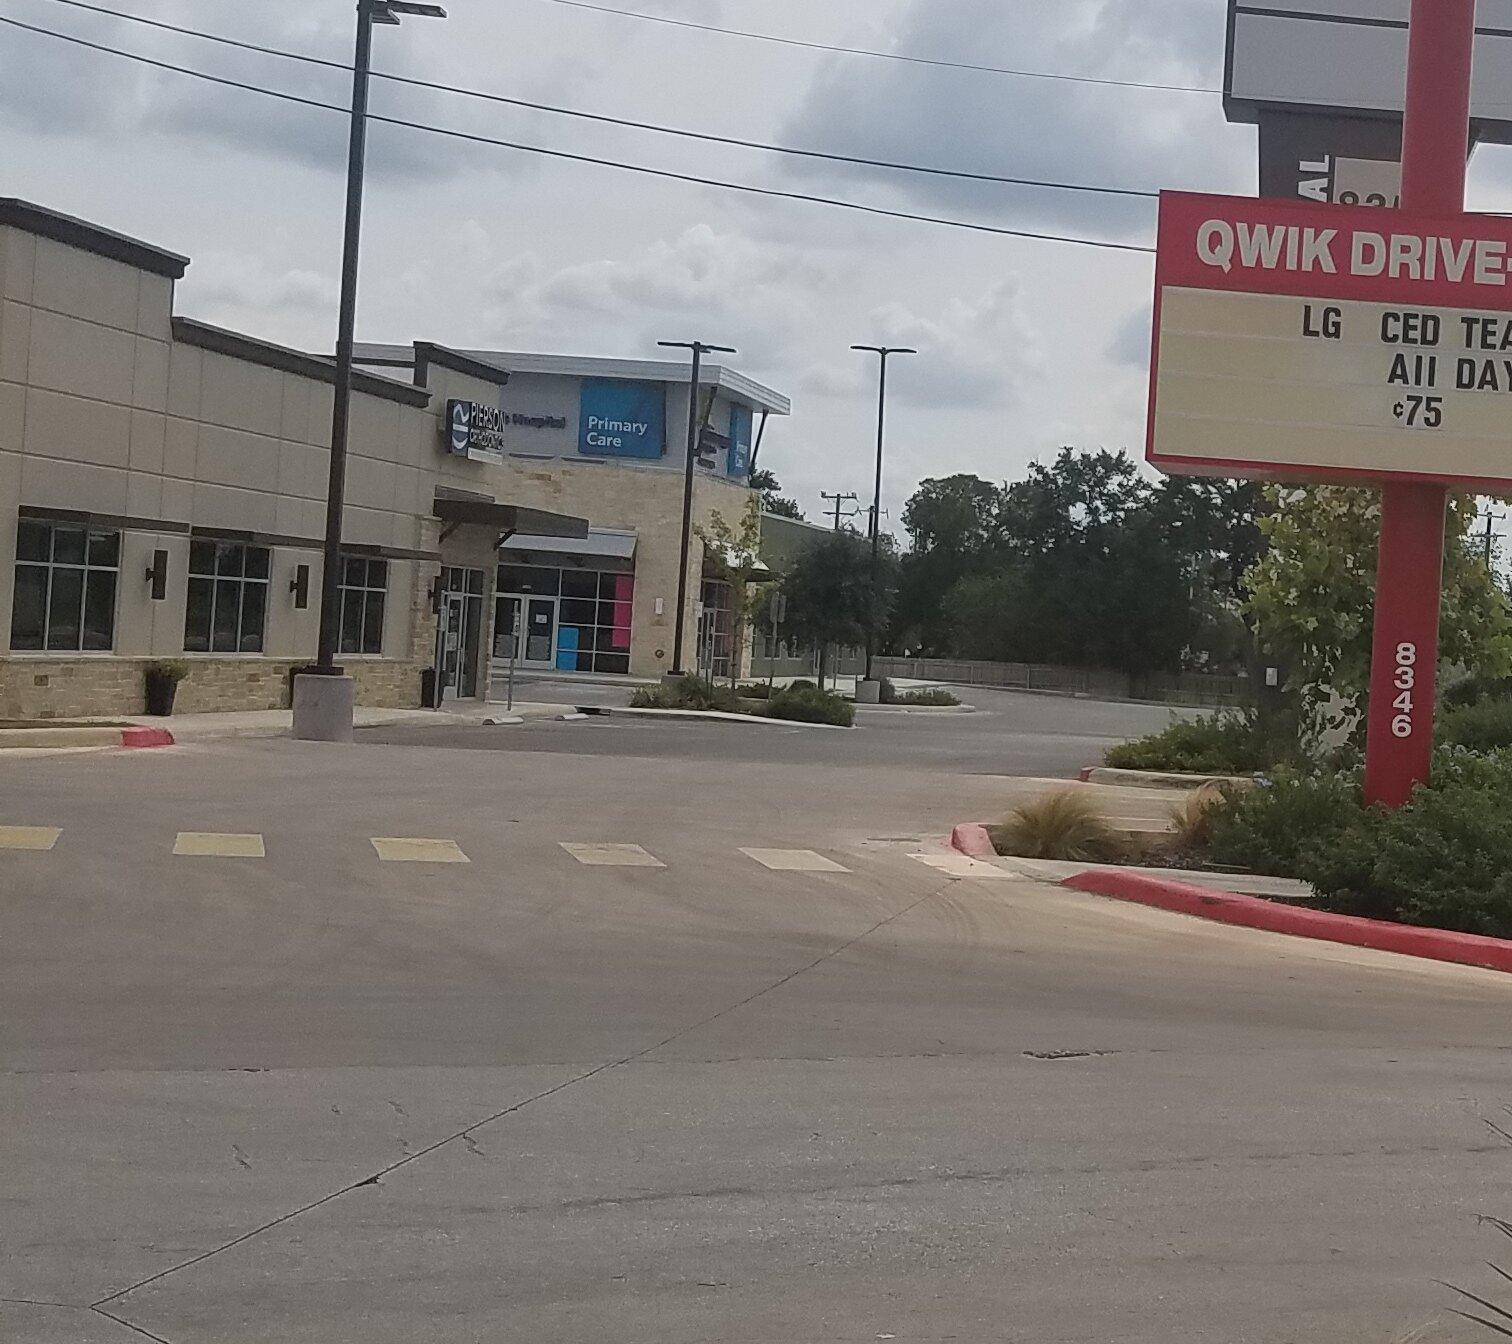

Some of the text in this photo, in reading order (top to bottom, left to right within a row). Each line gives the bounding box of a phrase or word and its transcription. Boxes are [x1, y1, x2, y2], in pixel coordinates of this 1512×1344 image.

[1196, 219, 1339, 274] QWIK
[1302, 305, 1341, 339] LG
[1381, 312, 1441, 346] CED
[470, 402, 505, 432] PIERSON
[588, 416, 648, 435] Primary
[586, 432, 622, 447] Care
[1391, 642, 1416, 738] 8346
